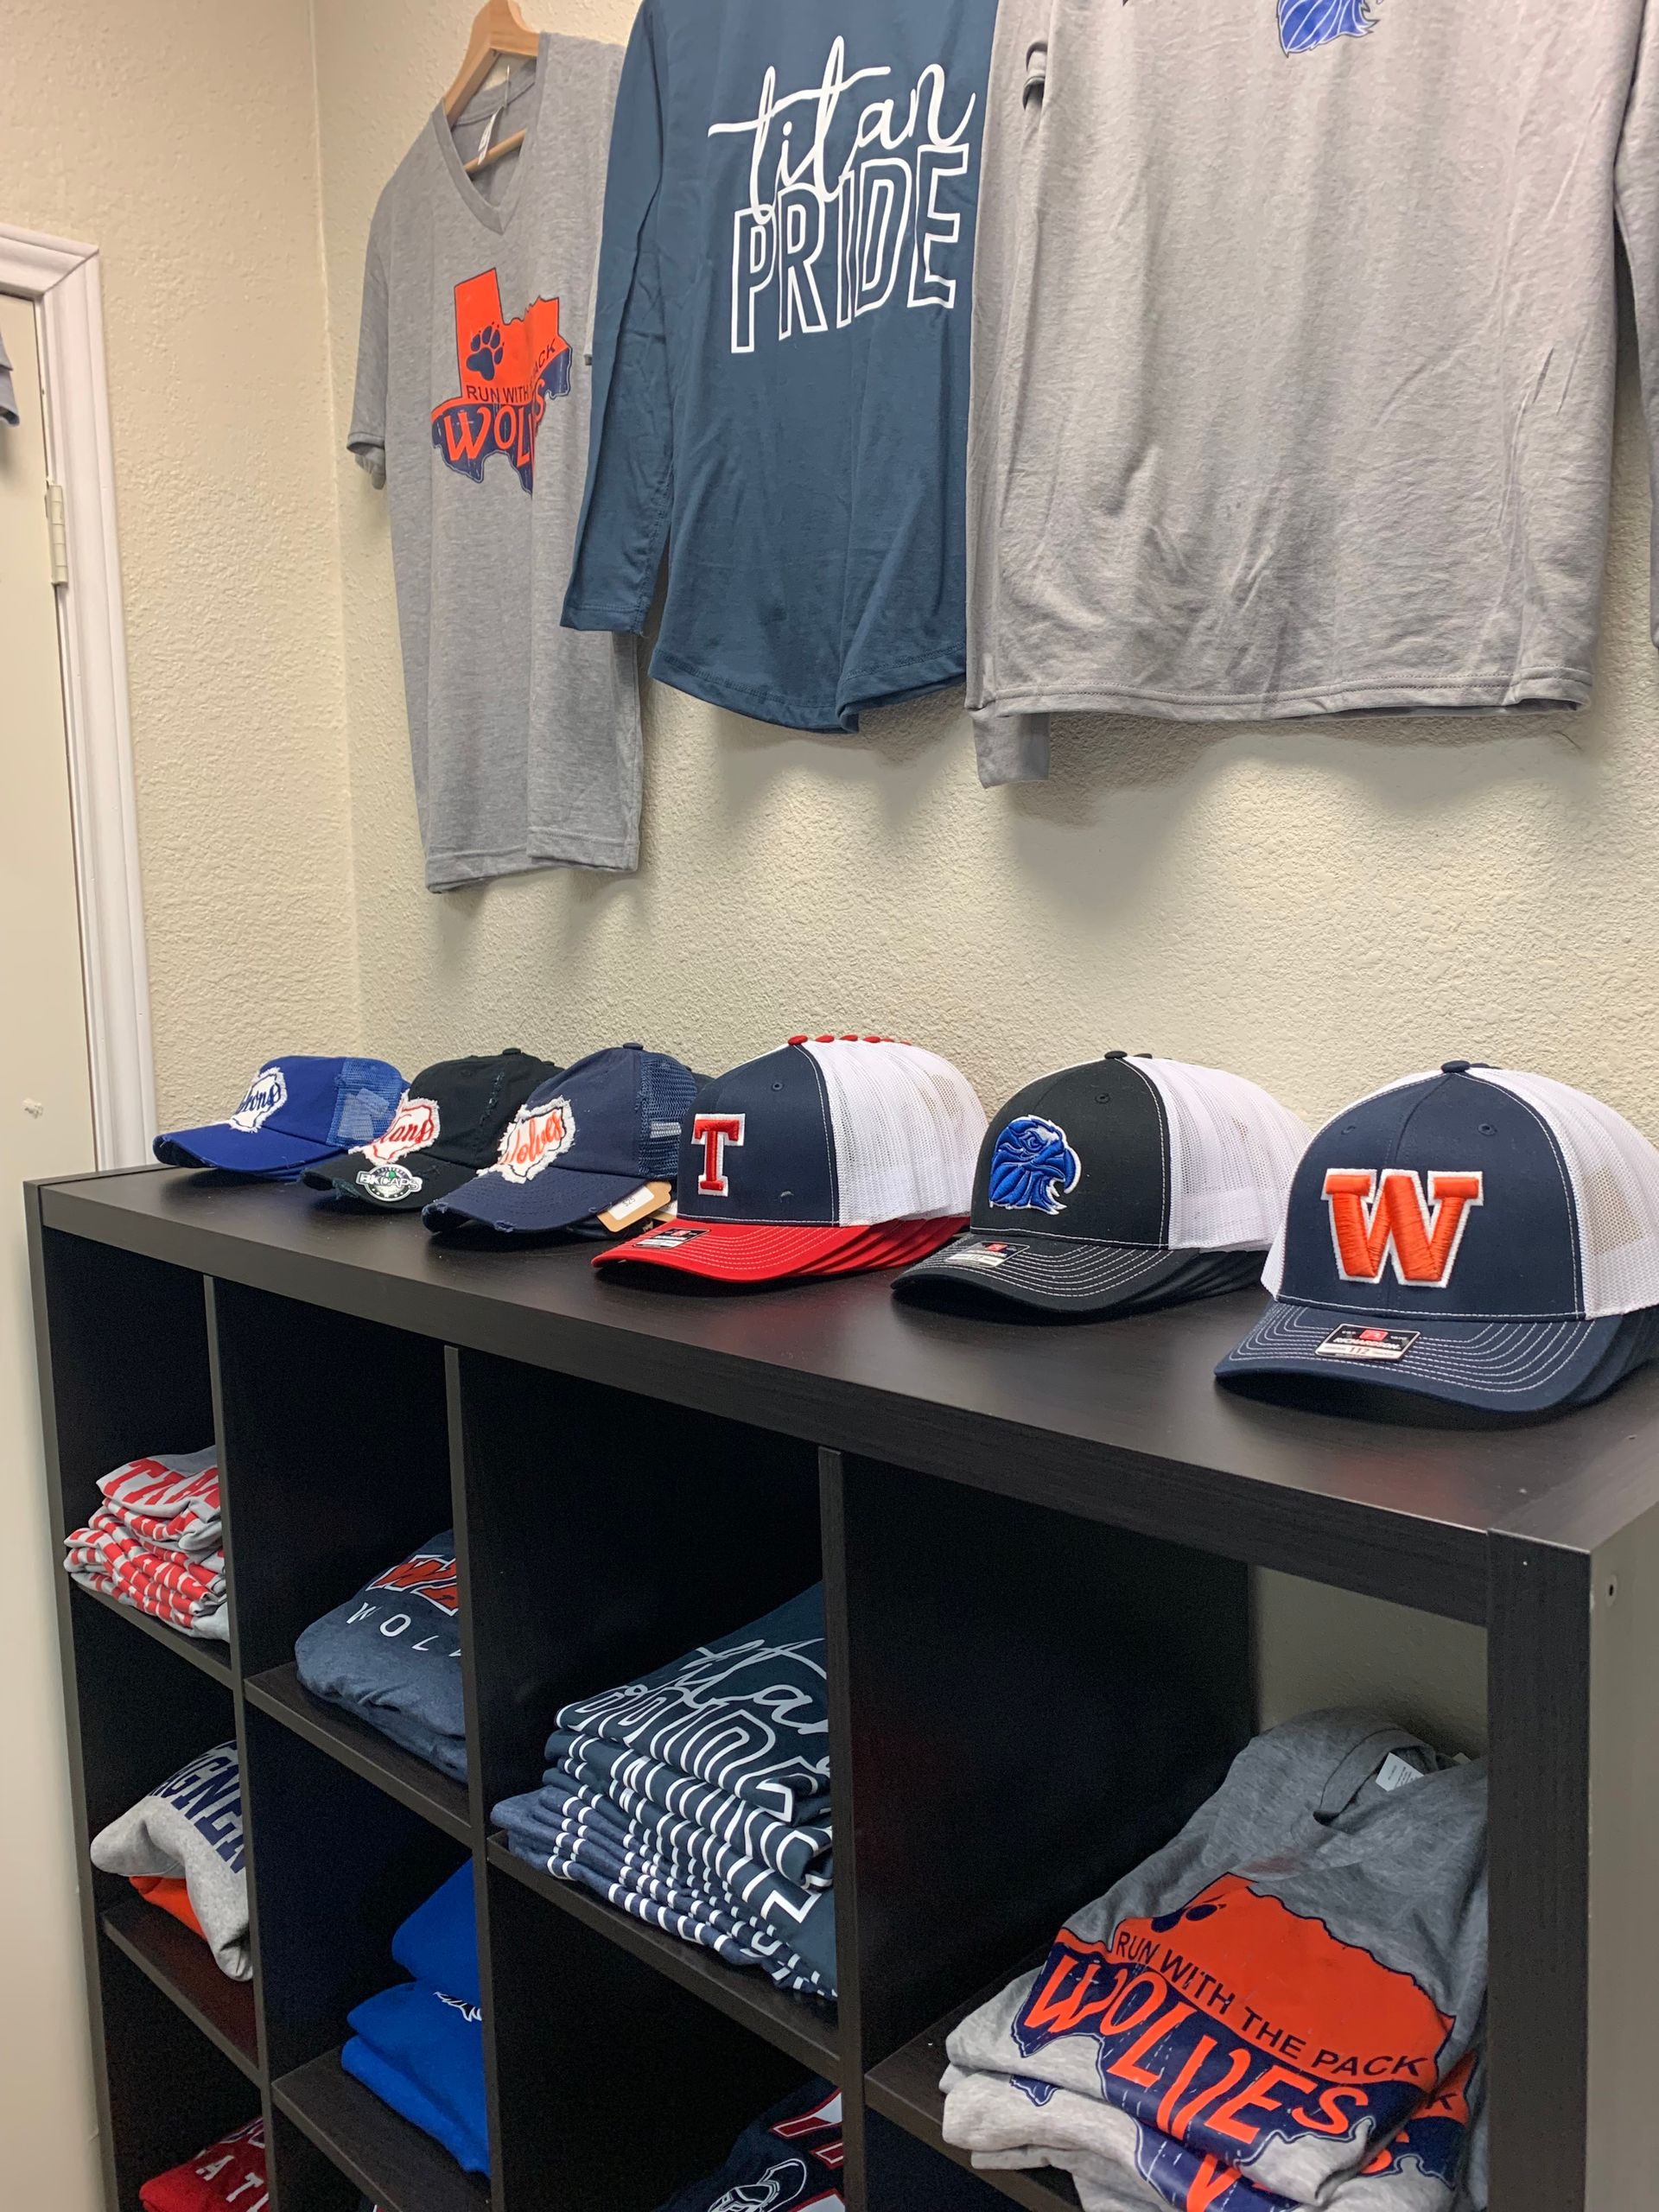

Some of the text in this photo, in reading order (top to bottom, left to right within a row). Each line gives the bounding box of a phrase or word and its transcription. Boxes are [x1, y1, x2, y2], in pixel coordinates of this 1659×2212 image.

[708, 35, 976, 225] titan
[731, 143, 970, 354] PRIDE
[467, 385, 500, 403] RUN
[503, 386, 531, 404] WITH
[691, 1113, 746, 1198] T
[1320, 1168, 1484, 1288] W
[1116, 1930, 1427, 2078] RUN WITH THE PACK
